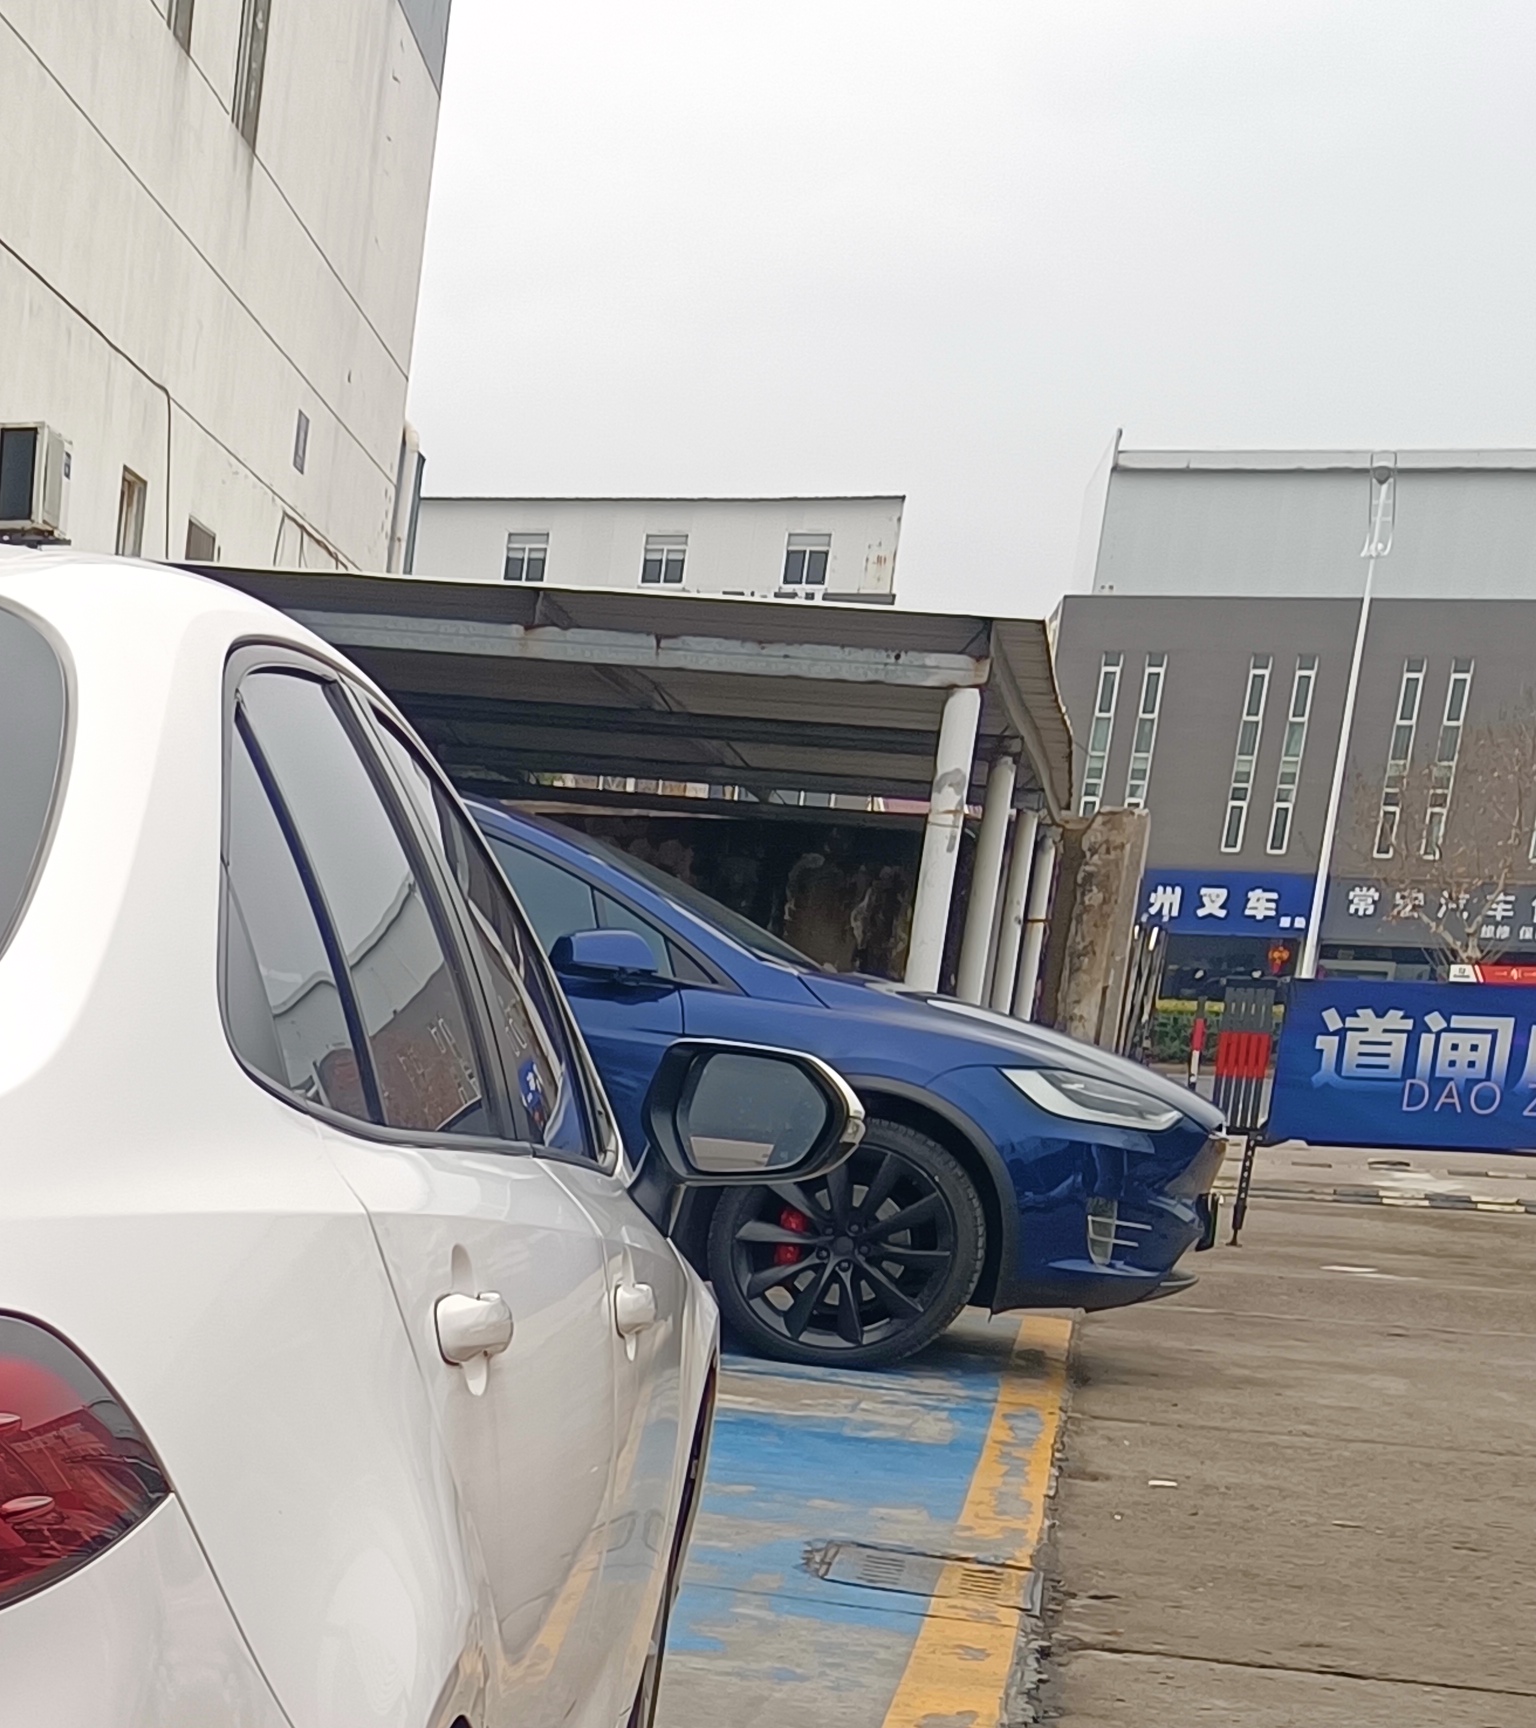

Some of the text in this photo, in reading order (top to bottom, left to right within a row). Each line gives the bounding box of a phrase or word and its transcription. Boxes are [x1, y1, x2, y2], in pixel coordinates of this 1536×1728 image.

[1148, 885, 1280, 920] 州叉车
[1310, 1006, 1536, 1093] 道闸
[1401, 1079, 1501, 1115] DAO
